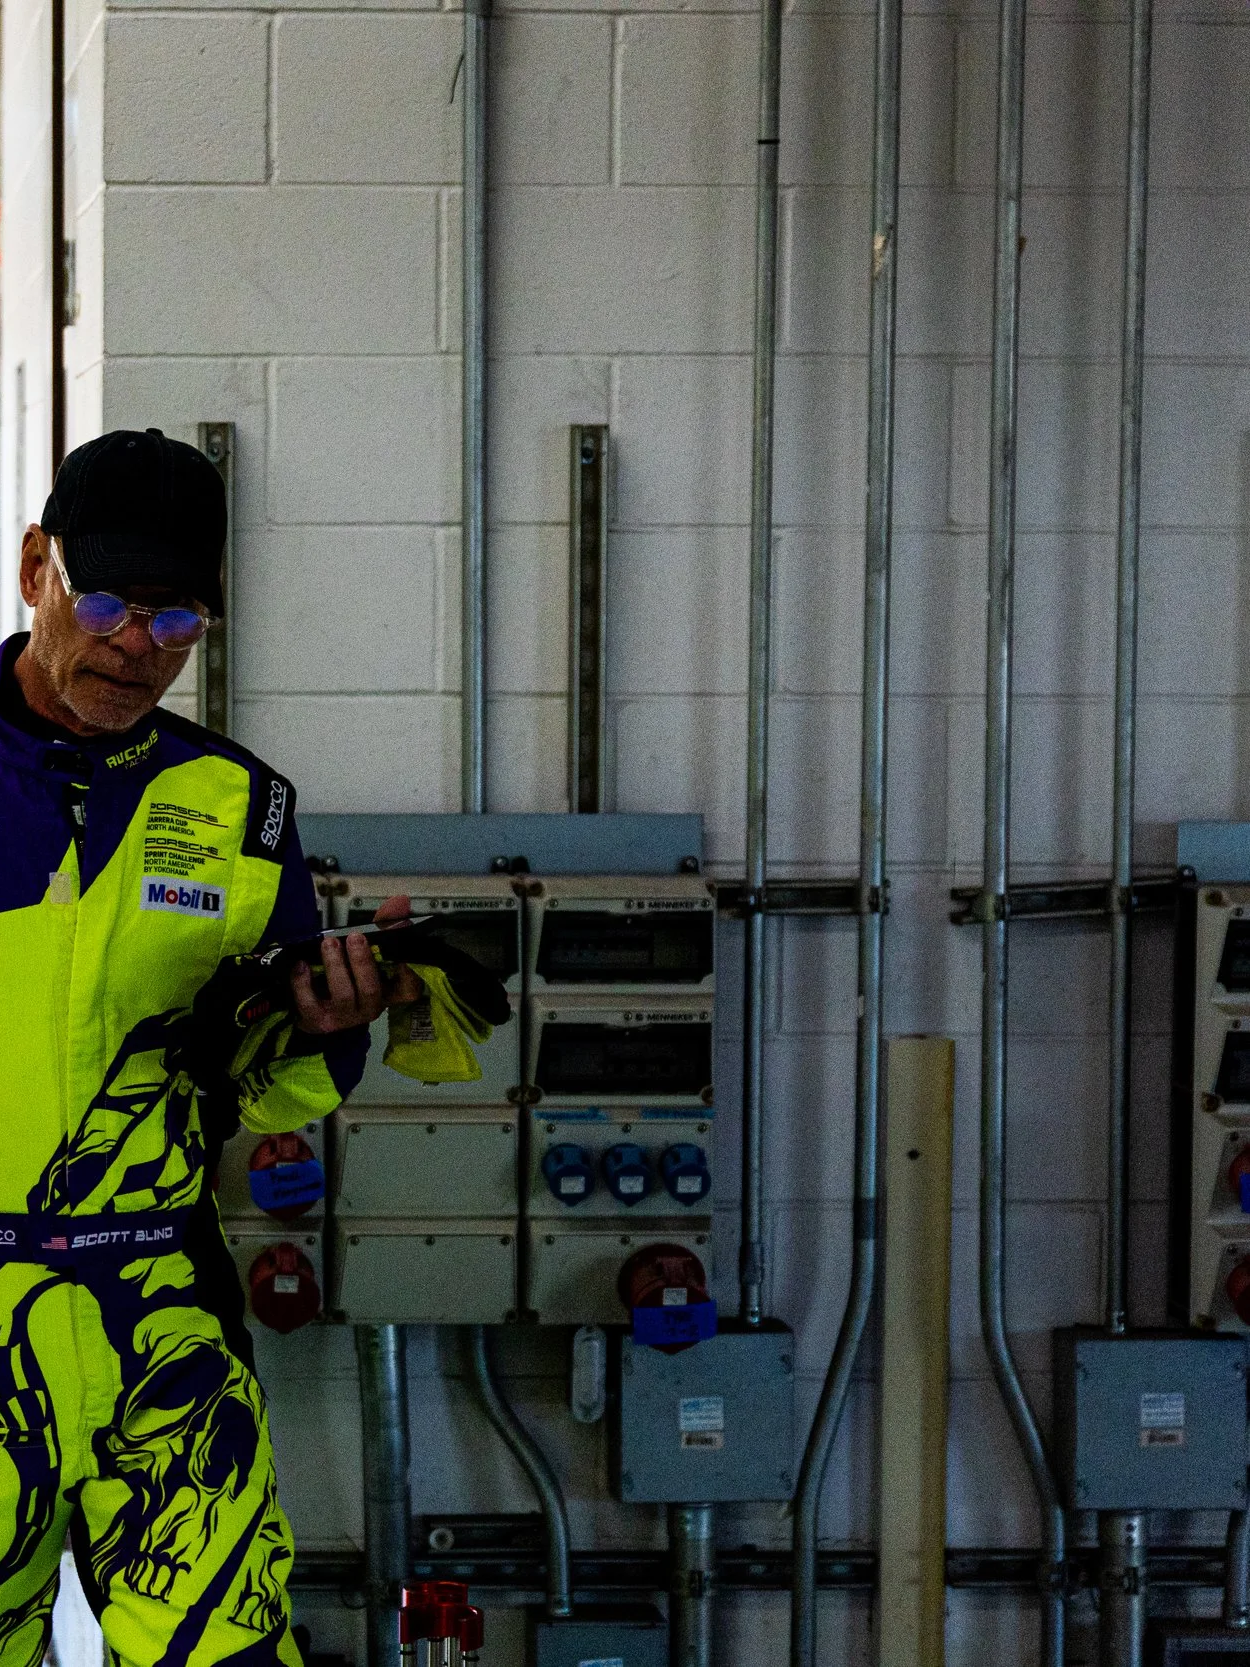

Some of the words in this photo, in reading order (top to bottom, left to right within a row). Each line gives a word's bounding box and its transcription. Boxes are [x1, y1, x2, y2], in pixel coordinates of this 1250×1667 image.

[105, 728, 159, 769] RUCKUS
[261, 780, 286, 849] sparco
[175, 818, 188, 827] CUP
[168, 825, 195, 836] AMERICA
[145, 838, 219, 856] PORSCHE
[168, 852, 206, 865] CHALLENGE
[168, 860, 196, 871] AMERICA
[154, 866, 189, 877] YOKOHAMA
[148, 883, 200, 908] Mobil
[71, 1230, 130, 1249] SCOTT
